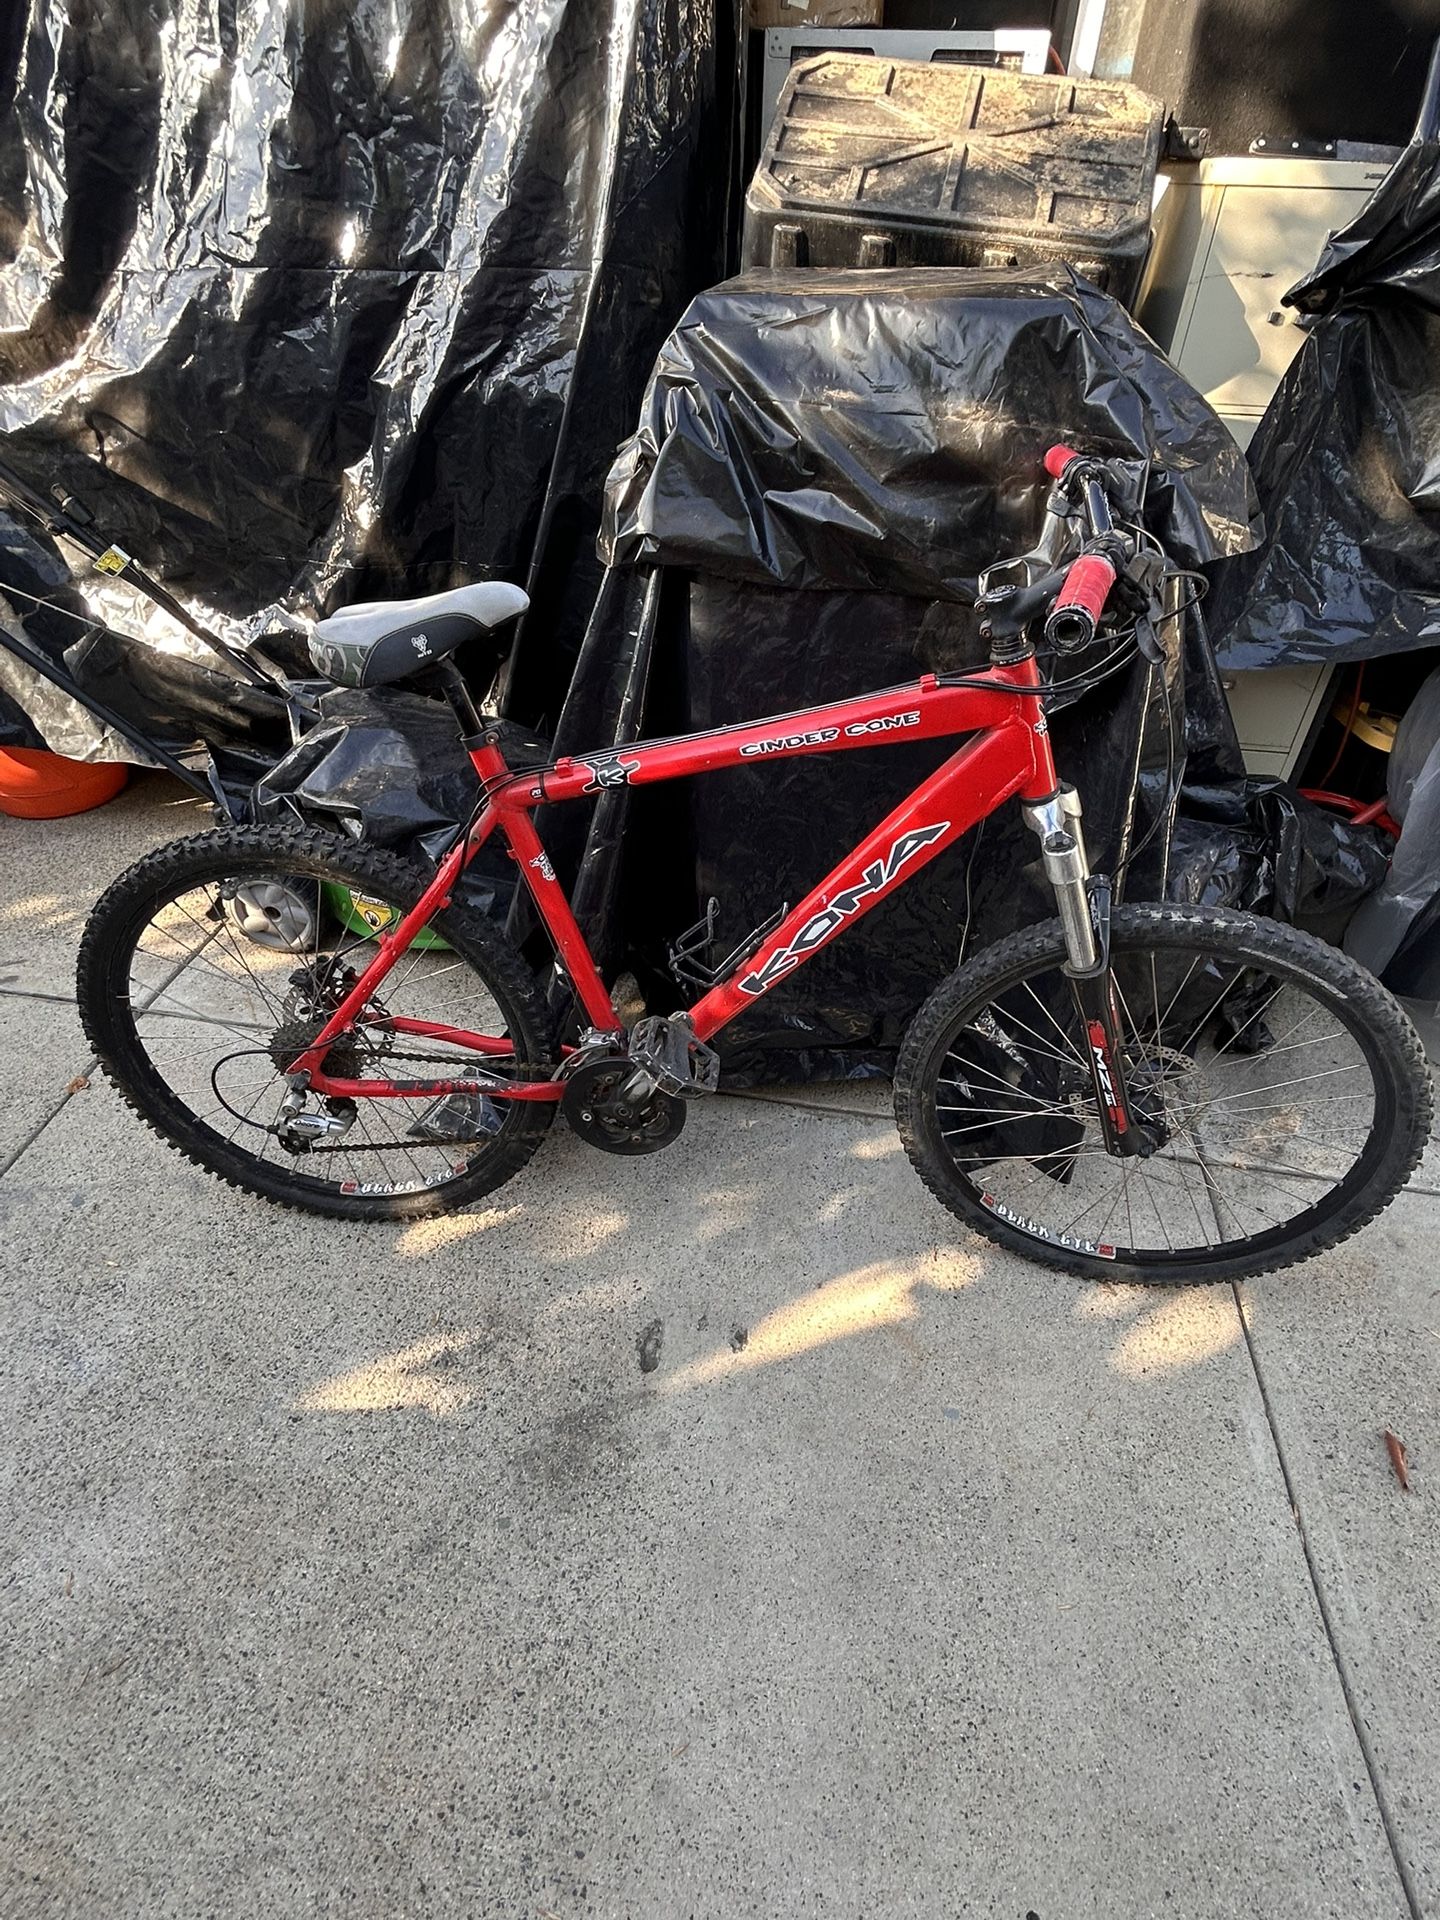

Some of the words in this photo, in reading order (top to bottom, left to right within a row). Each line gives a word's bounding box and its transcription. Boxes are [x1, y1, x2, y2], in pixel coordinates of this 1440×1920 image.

[739, 727, 840, 756] CINDER
[846, 710, 921, 736] CONE
[737, 820, 952, 996] KONA
